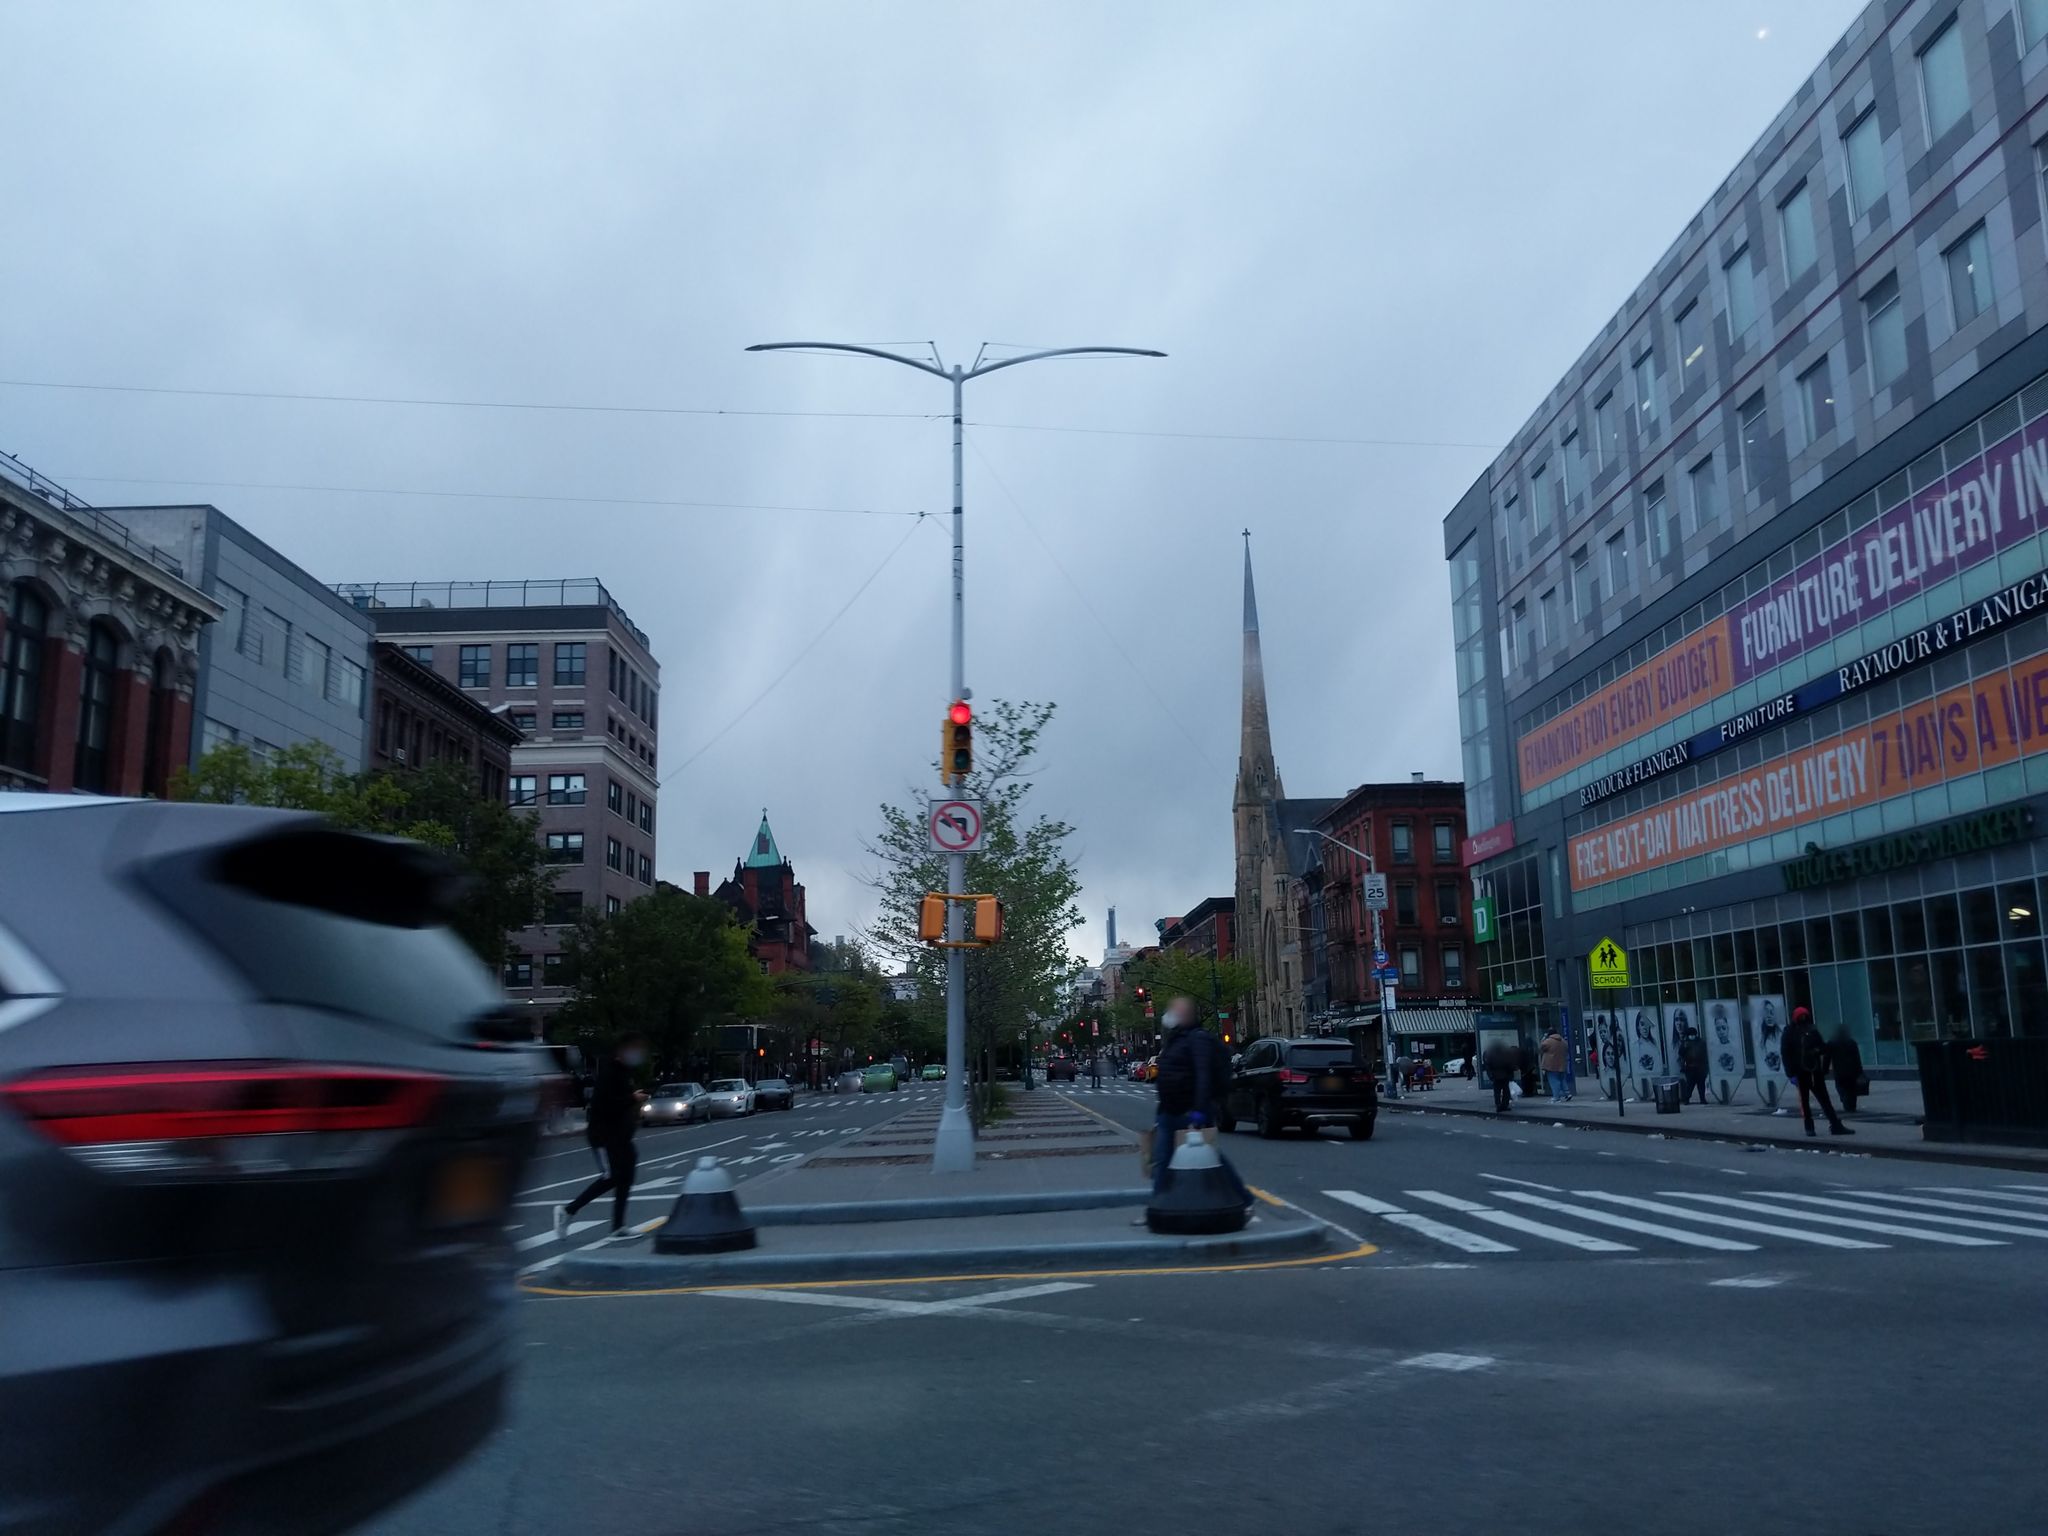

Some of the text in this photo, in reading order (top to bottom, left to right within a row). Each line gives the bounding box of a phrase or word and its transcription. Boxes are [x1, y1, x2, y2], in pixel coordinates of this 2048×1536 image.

[1740, 551, 1863, 667] FURNITURE
[1865, 463, 2003, 600] DELIVERY
[1838, 629, 1932, 693] RAYMOUR
[1935, 622, 1949, 650] &
[1524, 716, 1581, 781] FINANCING
[1610, 672, 1653, 736] EVERY
[1657, 635, 1719, 711] BUDGET
[1721, 694, 1795, 742] FURNITURE
[1575, 836, 1607, 881] FREE
[1606, 809, 1672, 867] NEXT-DAY
[1675, 778, 1763, 850] MATTRESS
[1765, 737, 1867, 821] DELIVERY
[1872, 730, 1888, 787] 7
[1895, 701, 1968, 780] DAYS
[1975, 691, 1998, 756] A
[1580, 741, 1689, 807] RAYMOUR & FLANIGAN
[1782, 804, 2031, 891] WHOLE FOODS MARKET
[1368, 887, 1385, 899] 25
[1473, 906, 1488, 935] TD
[1593, 975, 1626, 985] SCHOOL
